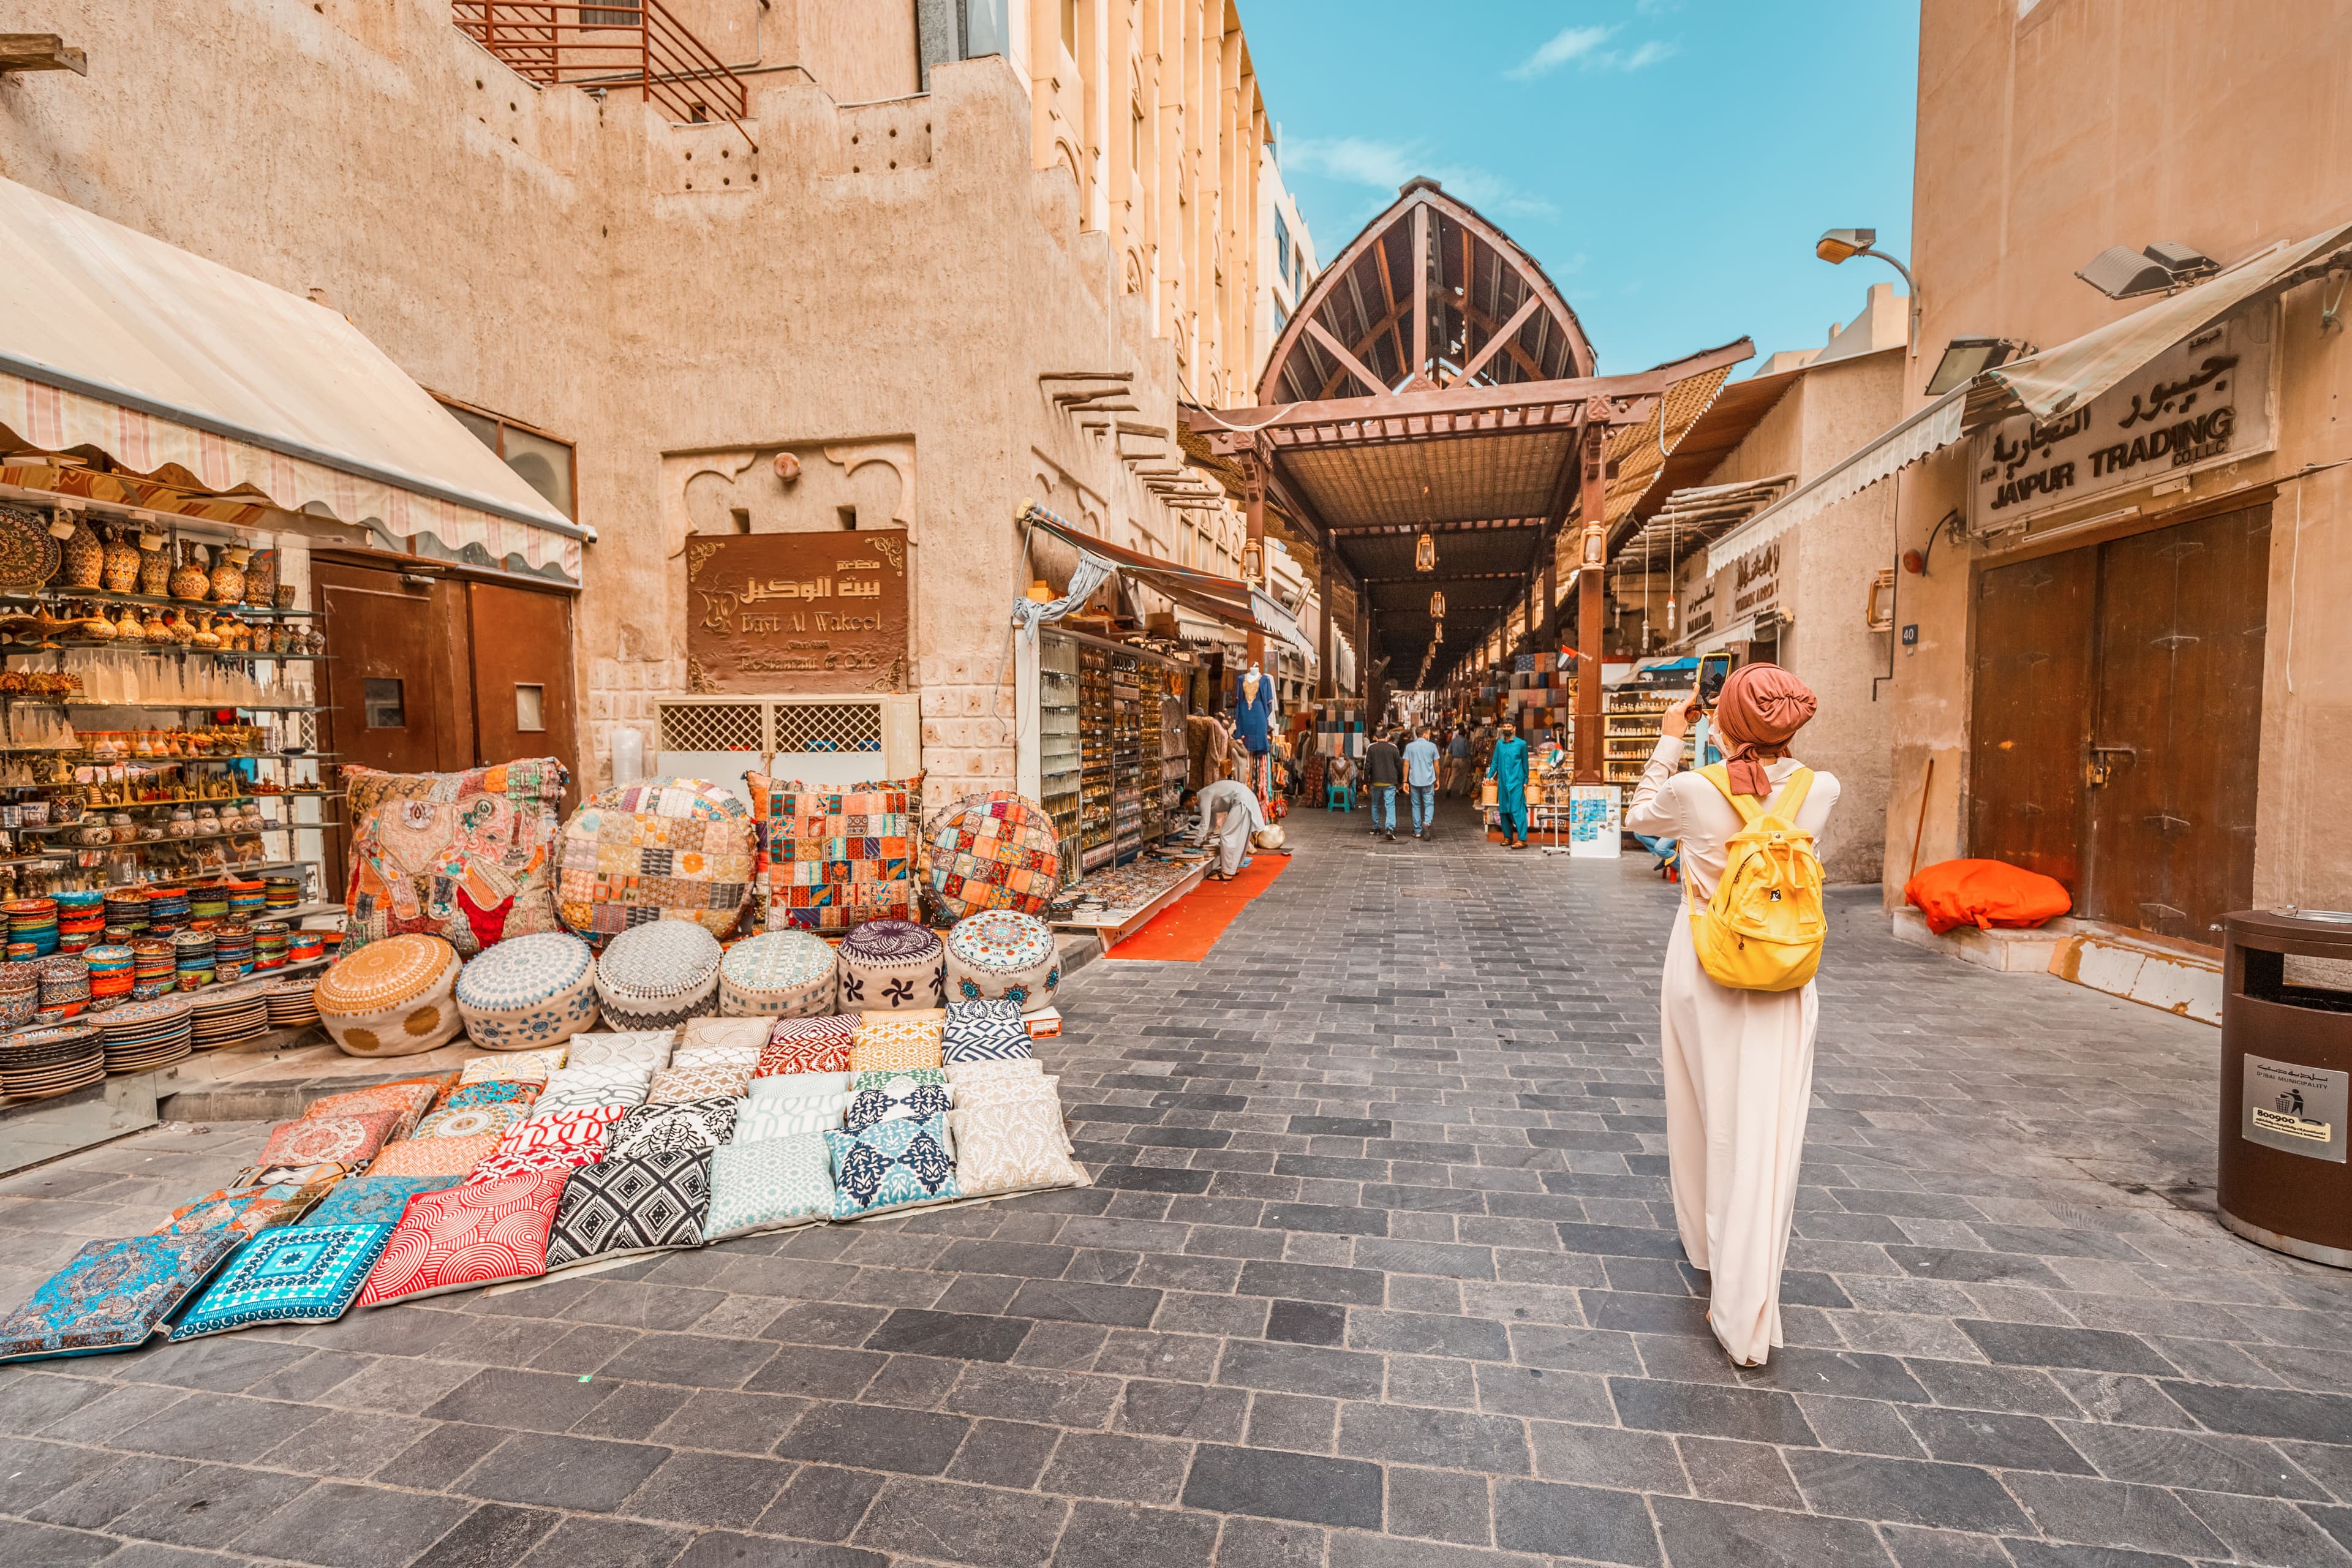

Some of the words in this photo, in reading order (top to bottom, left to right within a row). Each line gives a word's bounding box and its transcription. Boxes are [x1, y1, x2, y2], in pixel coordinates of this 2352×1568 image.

[1991, 462, 2075, 510] JAIPUR
[2088, 406, 2235, 477] TRADING
[2174, 450, 2190, 466] CO
[836, 560, 880, 571] مطعم
[739, 576, 831, 604] الوكيل
[838, 576, 880, 599] بيت
[741, 613, 780, 639] Bayt
[788, 612, 806, 632] Al
[814, 611, 881, 632] Wakeel
[1904, 628, 1913, 640] 40
[739, 656, 818, 670] Restaurant
[2278, 1077, 2328, 1089] MUNICIPALITY
[2287, 1071, 2328, 1081] بلدية
[2257, 1110, 2294, 1124] 800900
